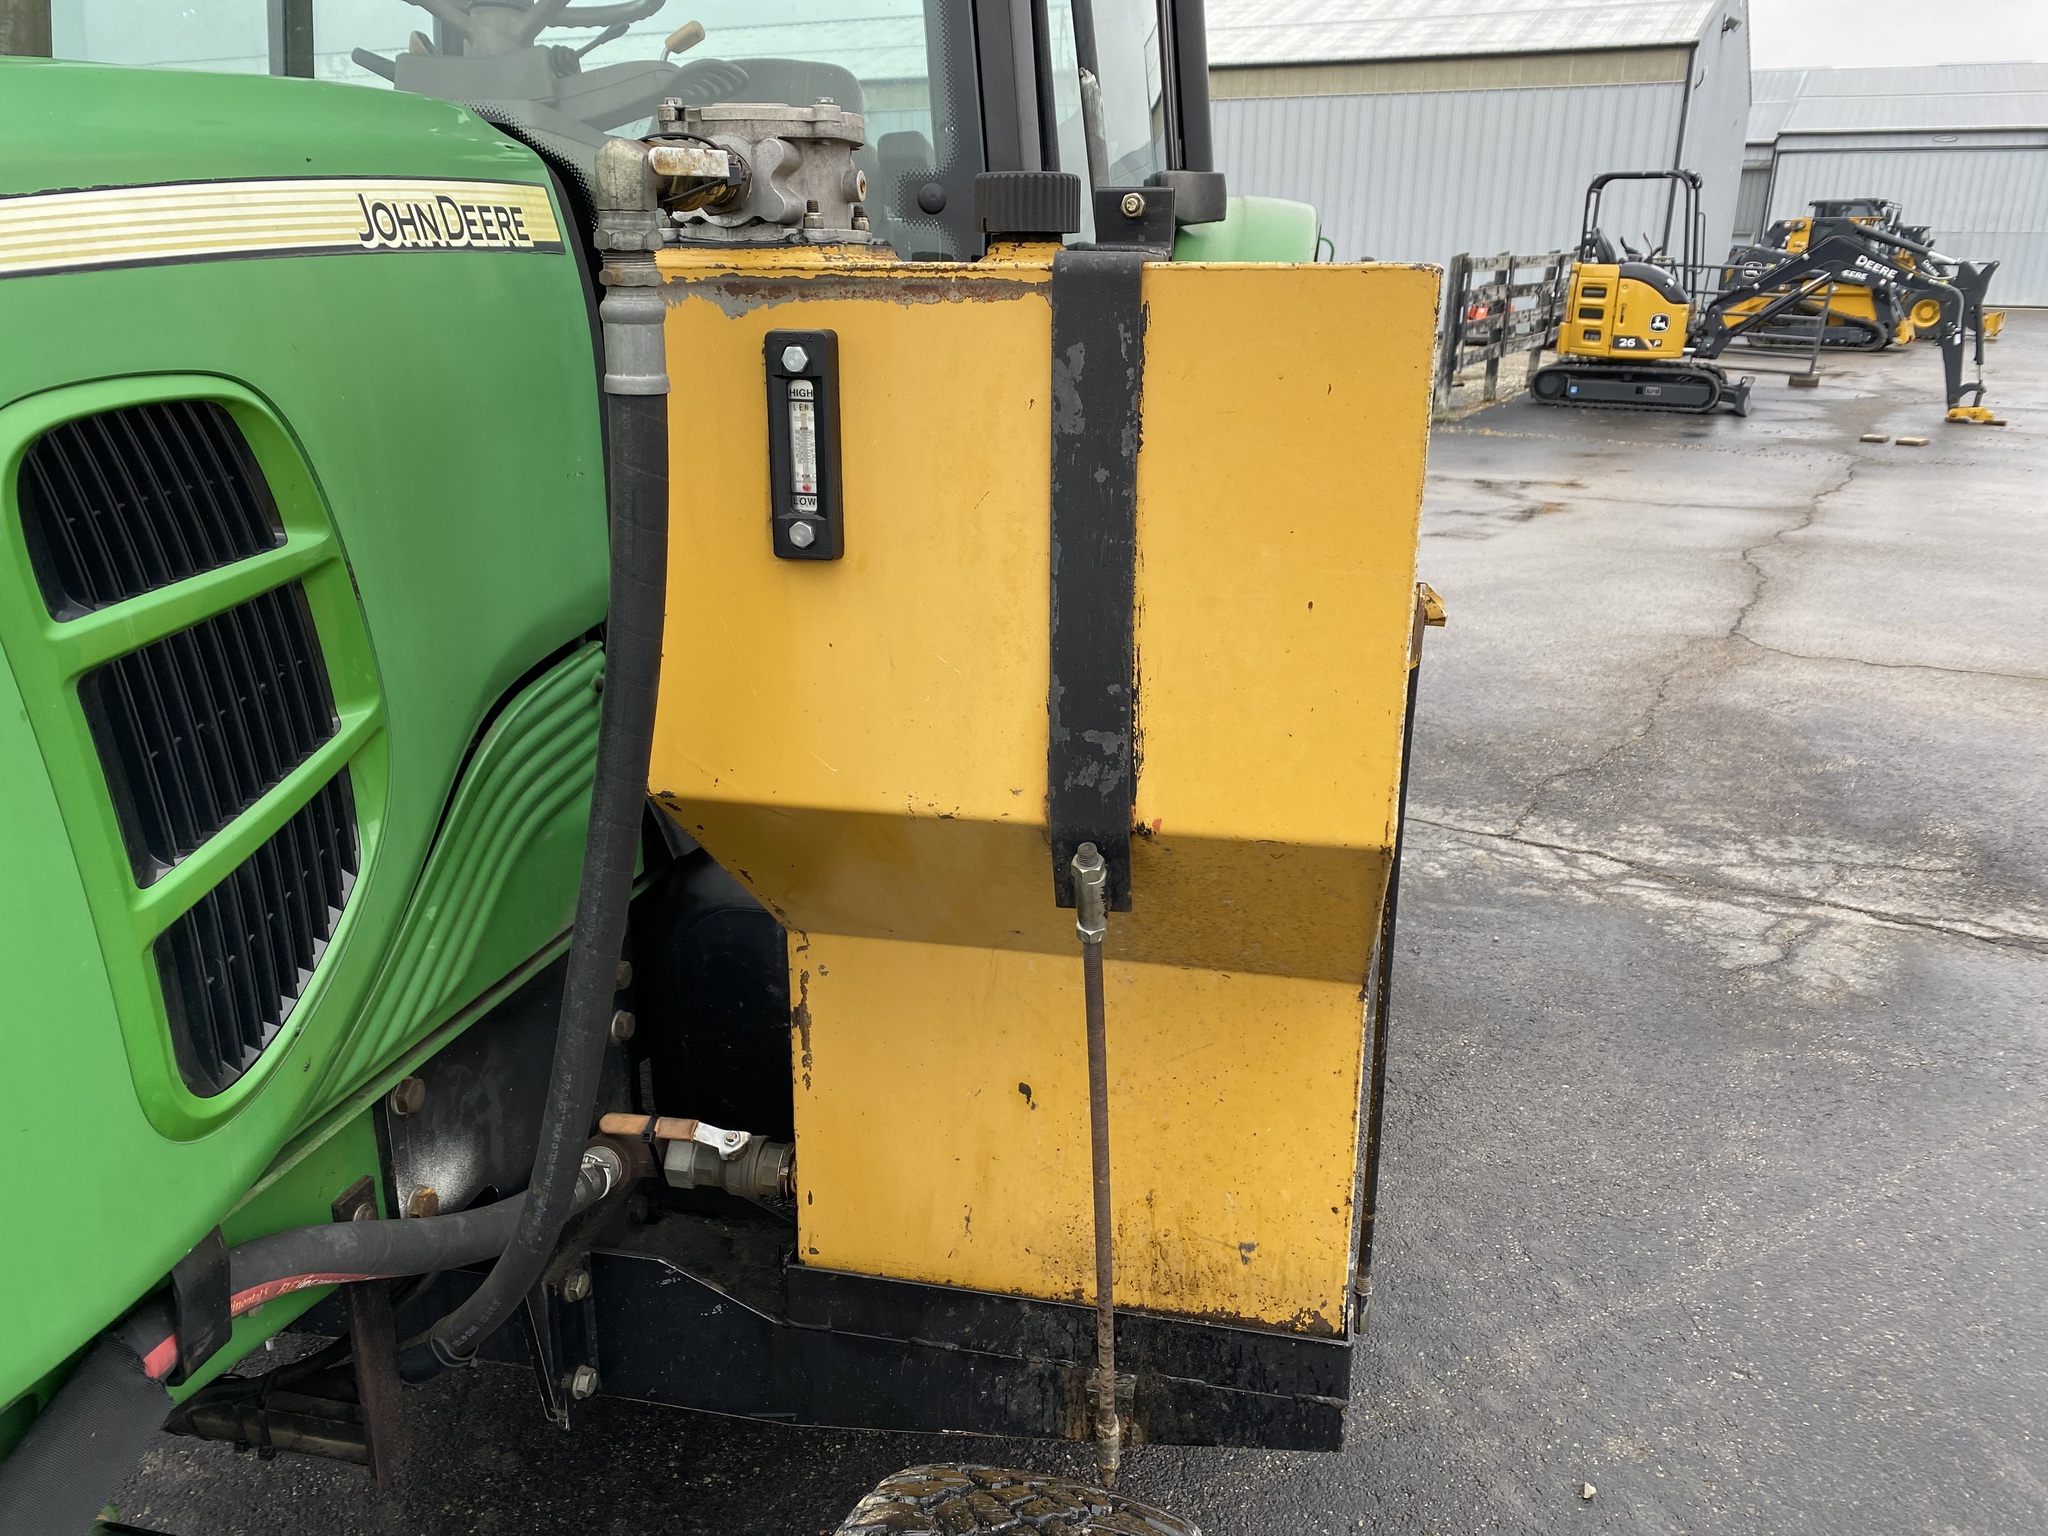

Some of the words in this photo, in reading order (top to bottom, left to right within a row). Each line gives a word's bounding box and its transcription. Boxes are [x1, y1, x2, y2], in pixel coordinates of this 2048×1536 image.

[356, 192, 442, 243] JOHN
[435, 195, 530, 243] DEERE
[1855, 254, 1898, 280] DEERE
[1841, 269, 1869, 281] EERE
[1619, 338, 1636, 348] 26
[789, 388, 813, 397] HIGH
[793, 497, 816, 506] LOW
